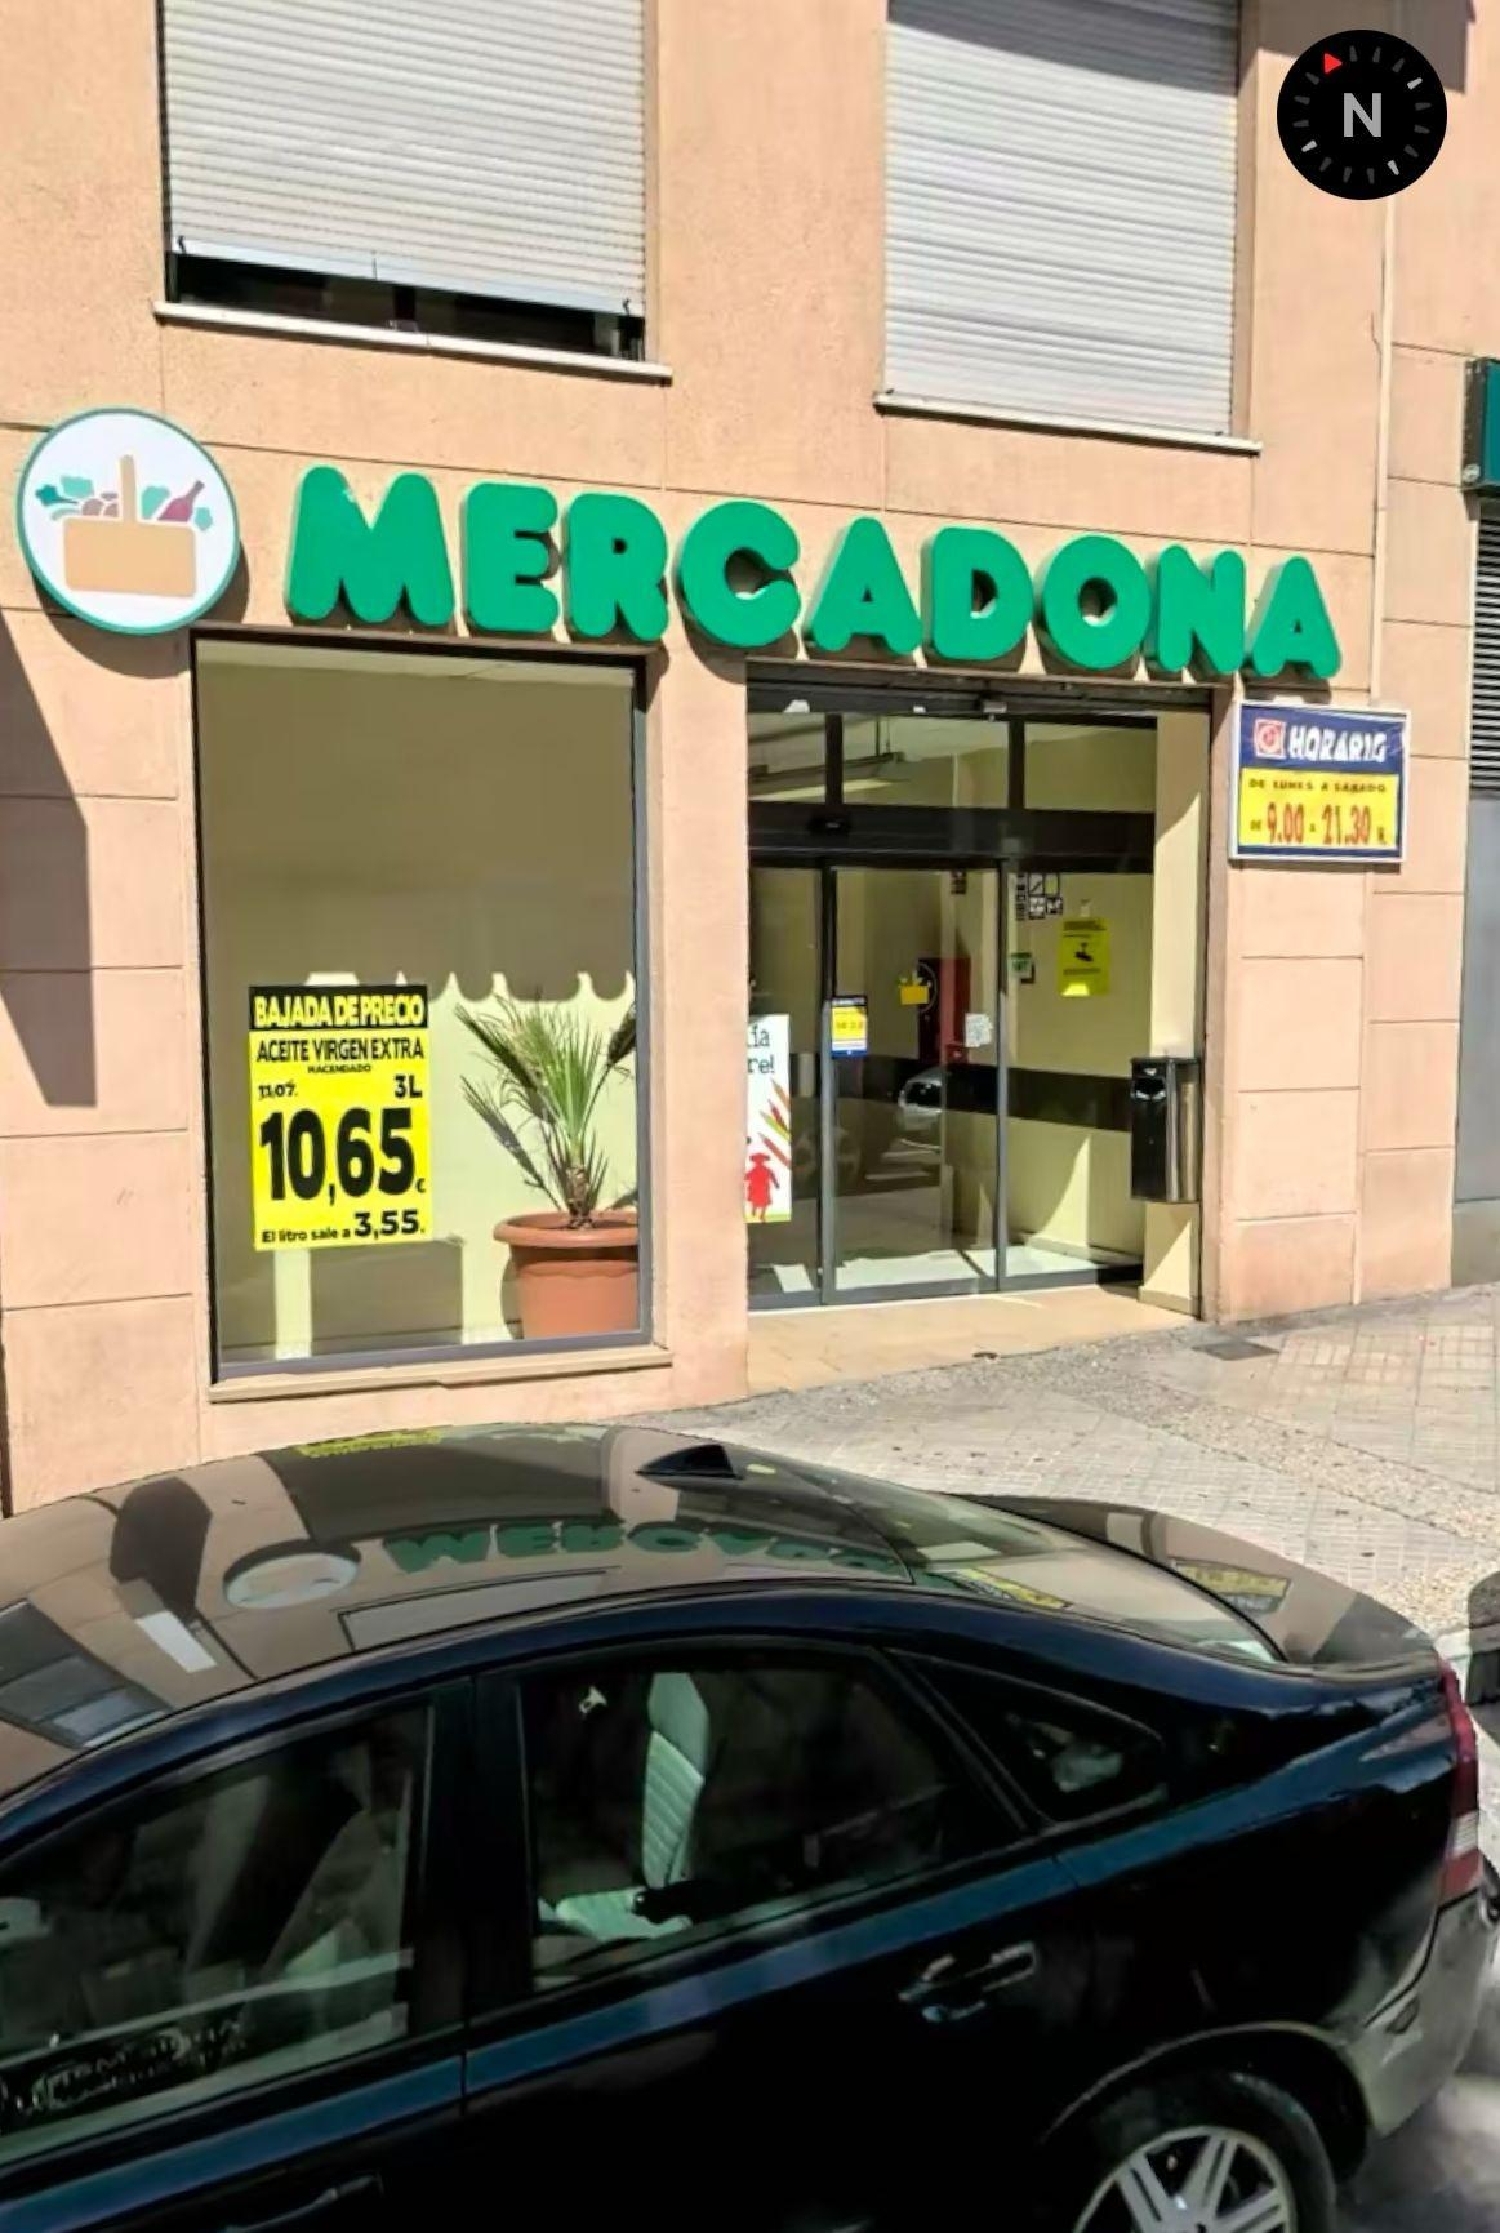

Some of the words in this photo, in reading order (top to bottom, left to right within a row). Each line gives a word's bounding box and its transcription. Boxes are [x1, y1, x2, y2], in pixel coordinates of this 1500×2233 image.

[287, 466, 1342, 679] MERCADONA
[1267, 801, 1304, 844] 9.00
[1321, 804, 1371, 845] 21.30
[254, 995, 332, 1028] BAJADA
[334, 995, 360, 1025] DE
[360, 994, 424, 1025] PRECIO
[257, 1040, 309, 1062] ACEITE
[313, 1037, 369, 1060] VIRGEN
[371, 1036, 424, 1059] EXTRA
[260, 1106, 415, 1206] 10,65
[279, 1230, 307, 1241] litro
[311, 1227, 338, 1240] sale
[354, 1209, 419, 1239] 3,55
